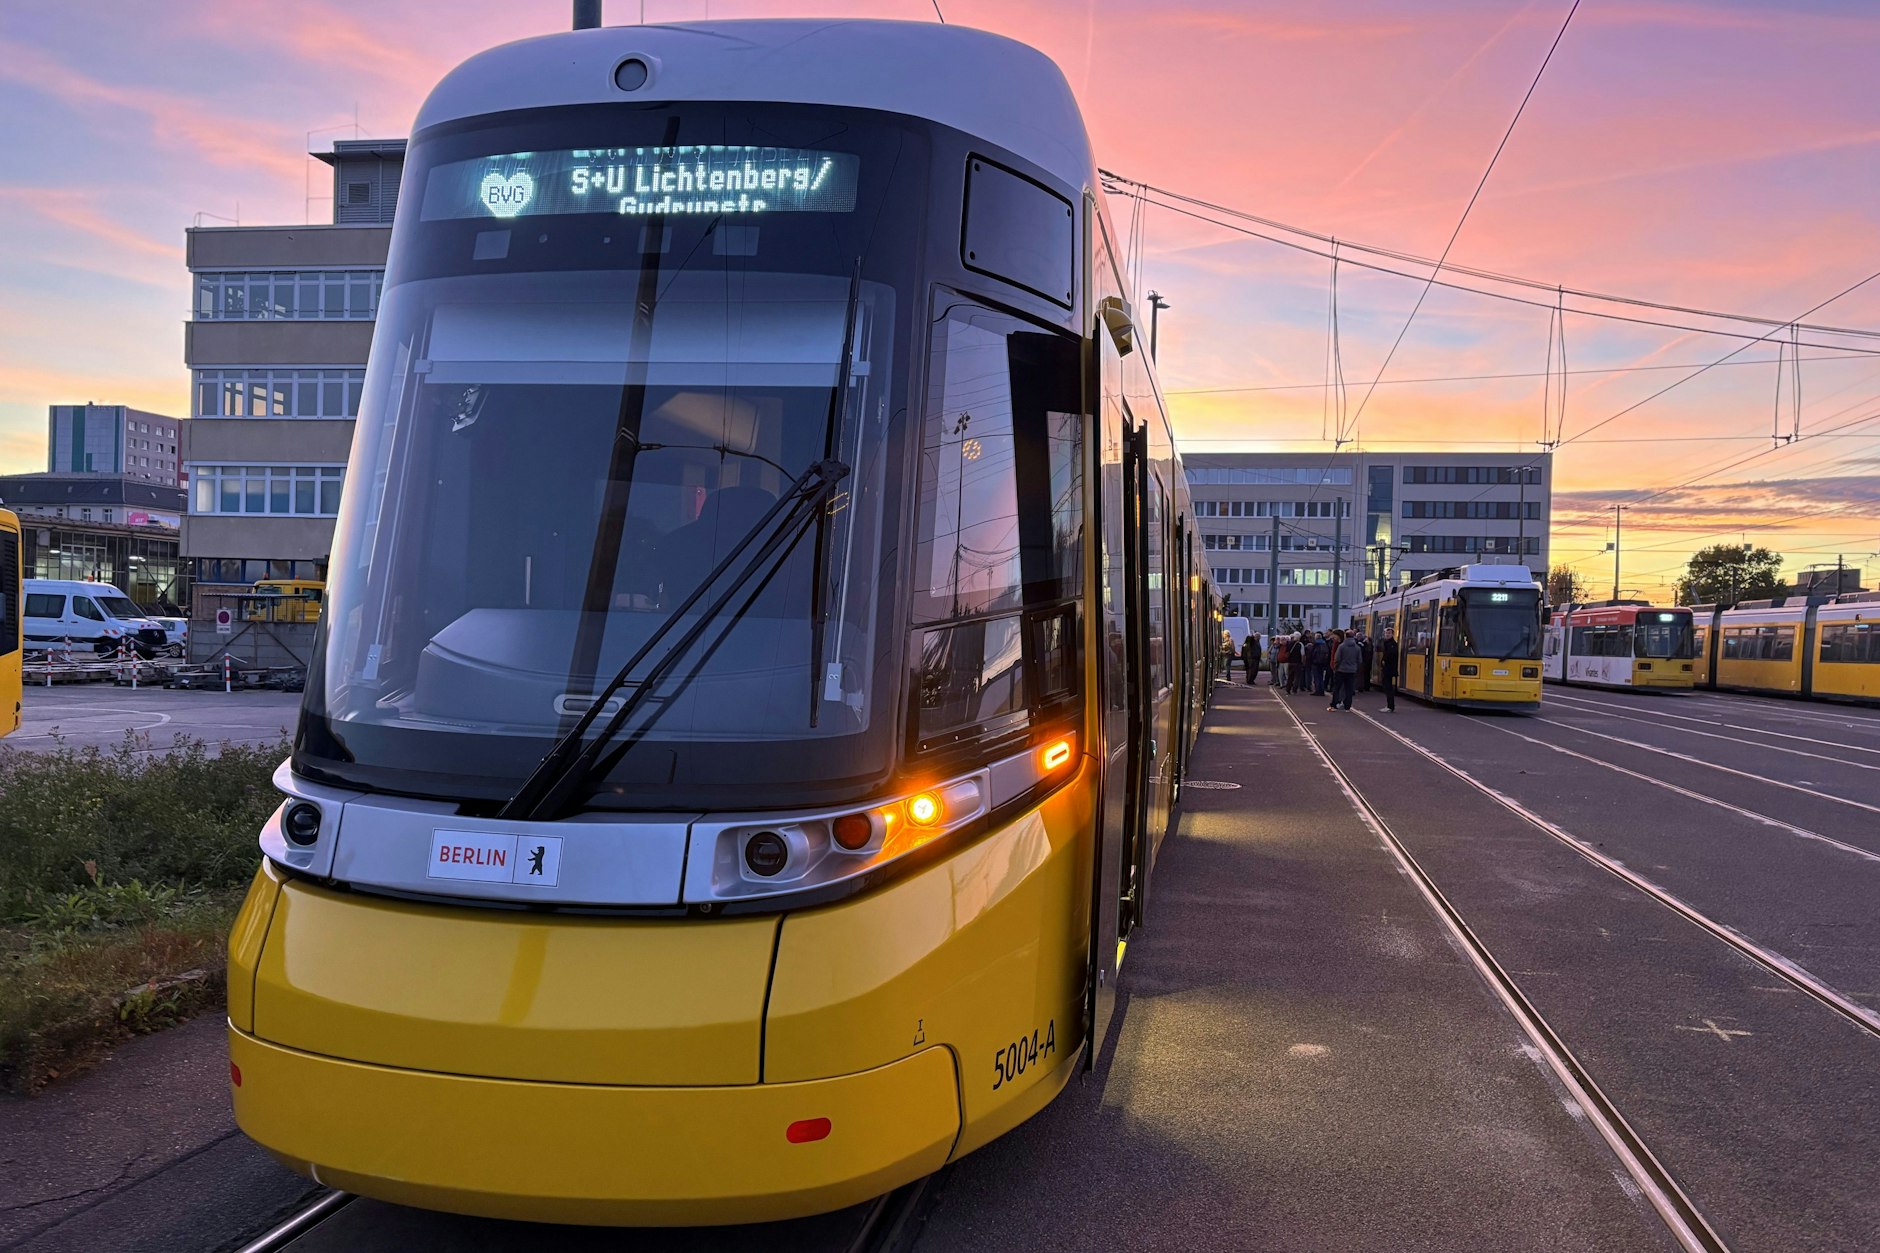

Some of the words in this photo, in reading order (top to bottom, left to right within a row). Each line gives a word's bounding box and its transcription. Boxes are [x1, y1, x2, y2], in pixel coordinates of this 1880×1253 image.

[571, 164, 624, 194] S+U
[635, 158, 832, 193] Lichtenberg/
[488, 185, 525, 204] BVG
[439, 845, 507, 867] BERLIN
[992, 1019, 1056, 1091] 5004-A
